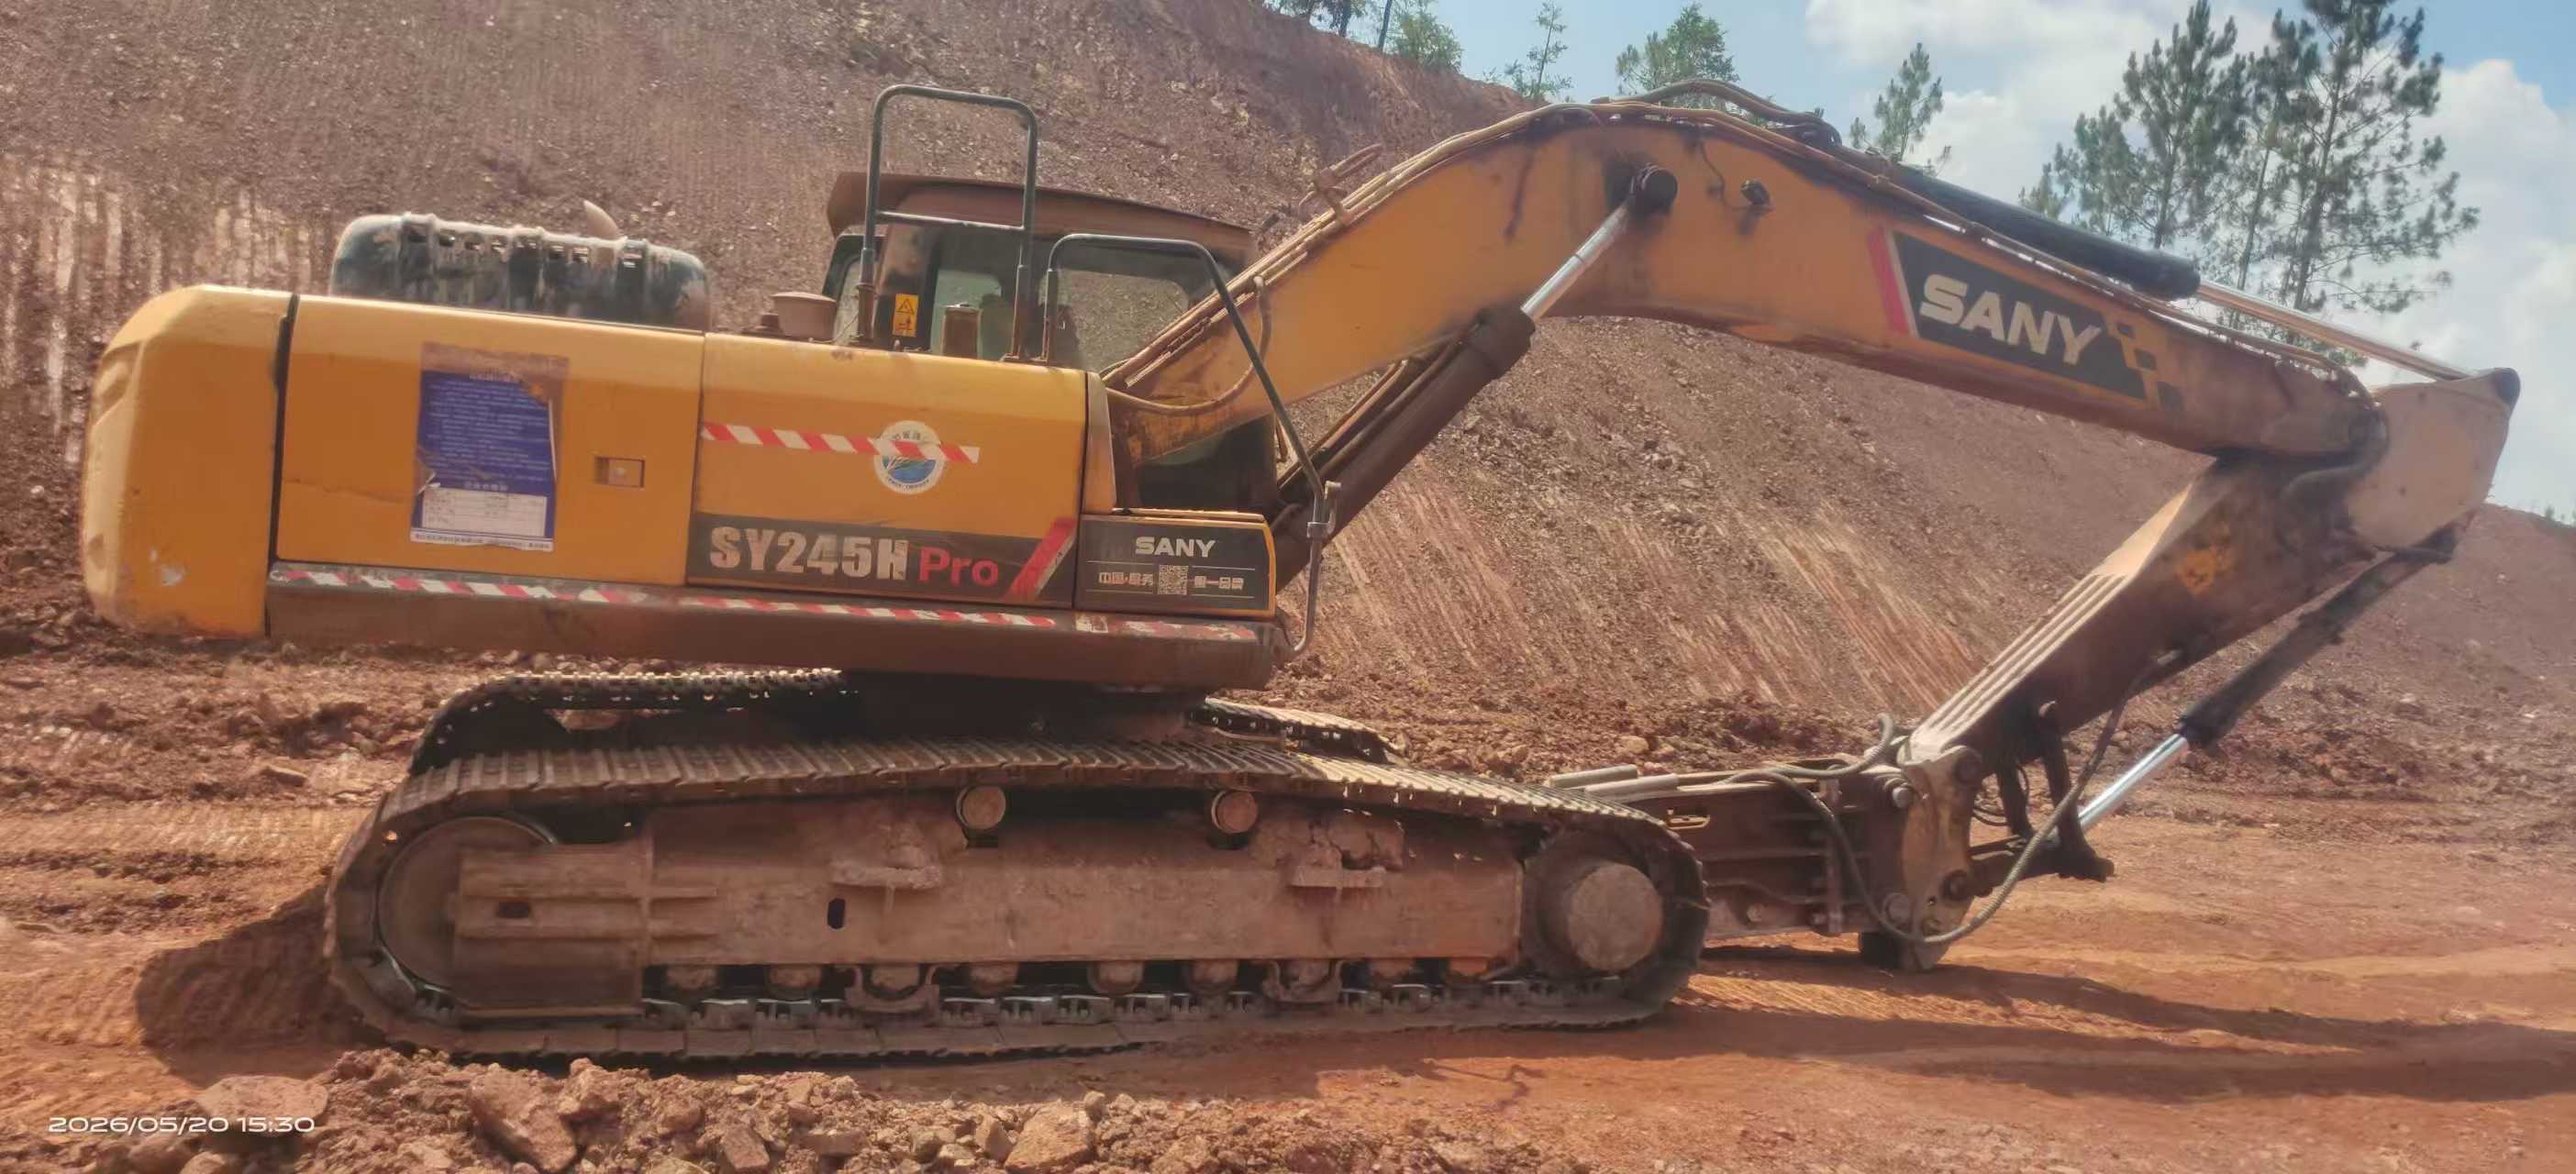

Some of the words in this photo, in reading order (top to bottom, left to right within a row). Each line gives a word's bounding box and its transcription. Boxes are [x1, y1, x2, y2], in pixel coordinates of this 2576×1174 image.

[1919, 273, 2102, 365] SANY
[709, 526, 909, 581] SY245H
[918, 546, 999, 588] Pro
[1135, 536, 1216, 559] SANY
